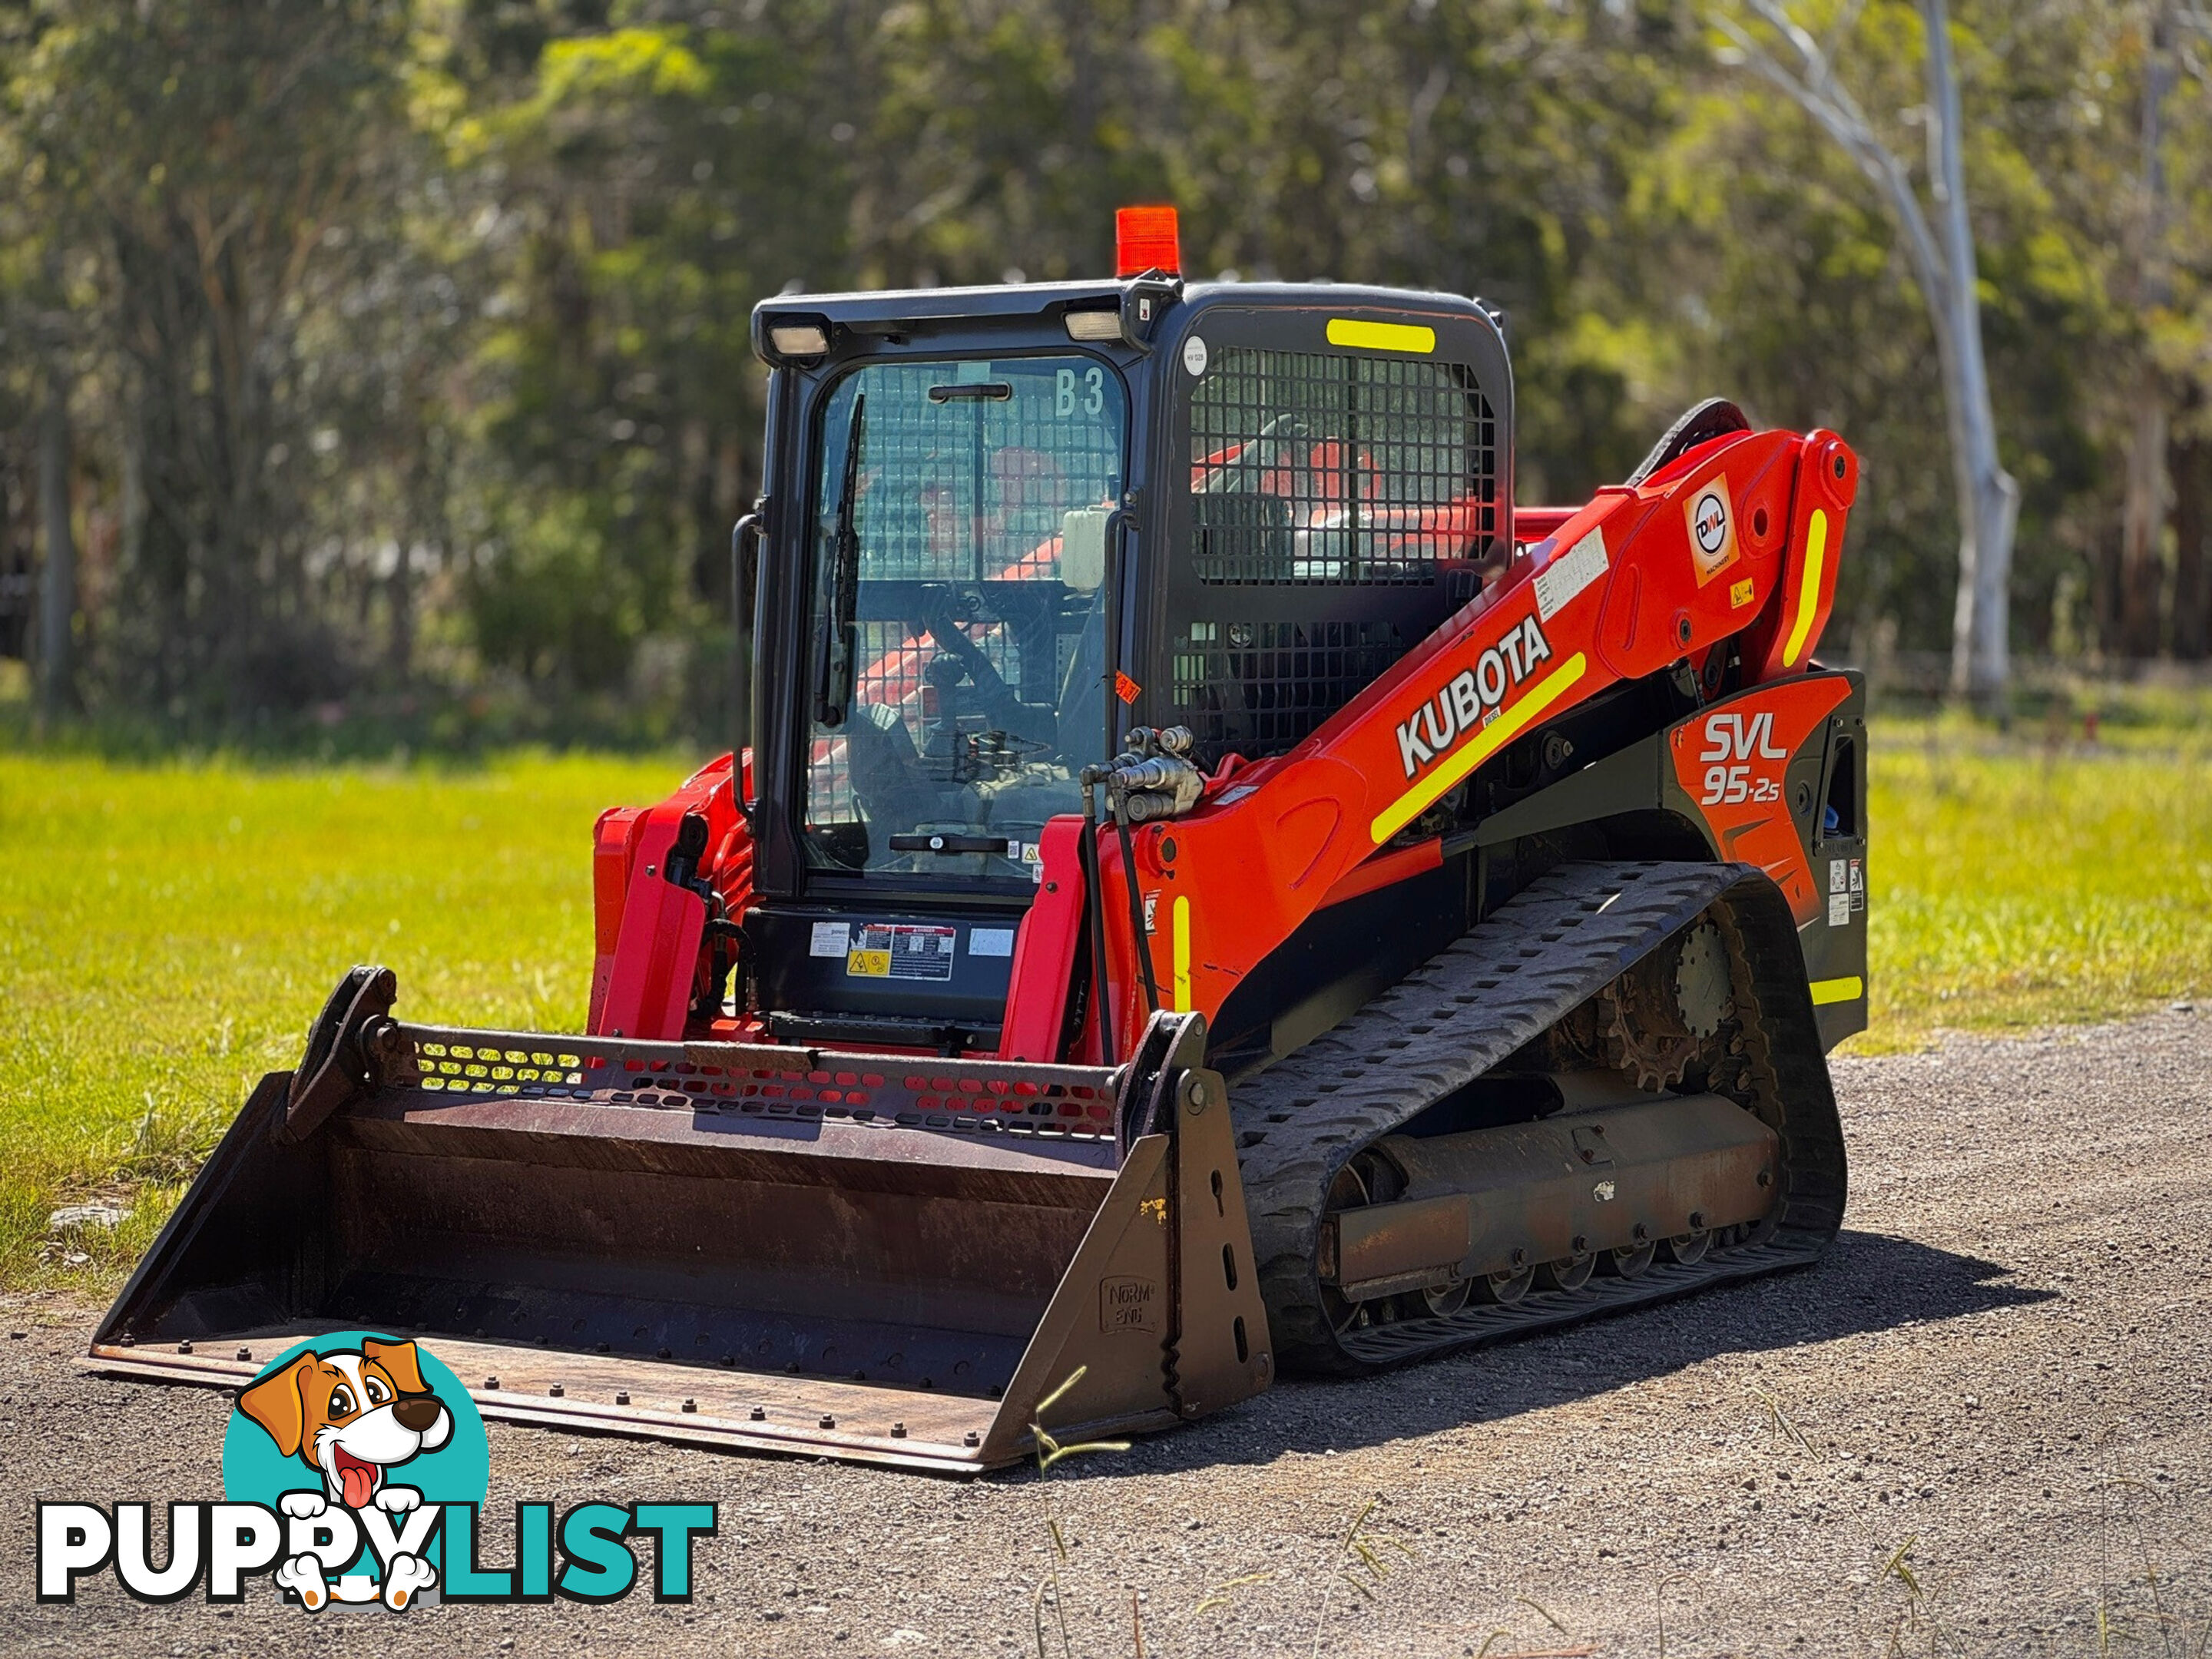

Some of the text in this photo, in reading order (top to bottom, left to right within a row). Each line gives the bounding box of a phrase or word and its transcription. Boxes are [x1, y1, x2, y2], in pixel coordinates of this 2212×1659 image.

[1696, 510, 1725, 538] DWL
[1706, 554, 1730, 575] MACHINERY
[1396, 614, 1551, 779] KUBOTA
[1700, 712, 1788, 762] SVL
